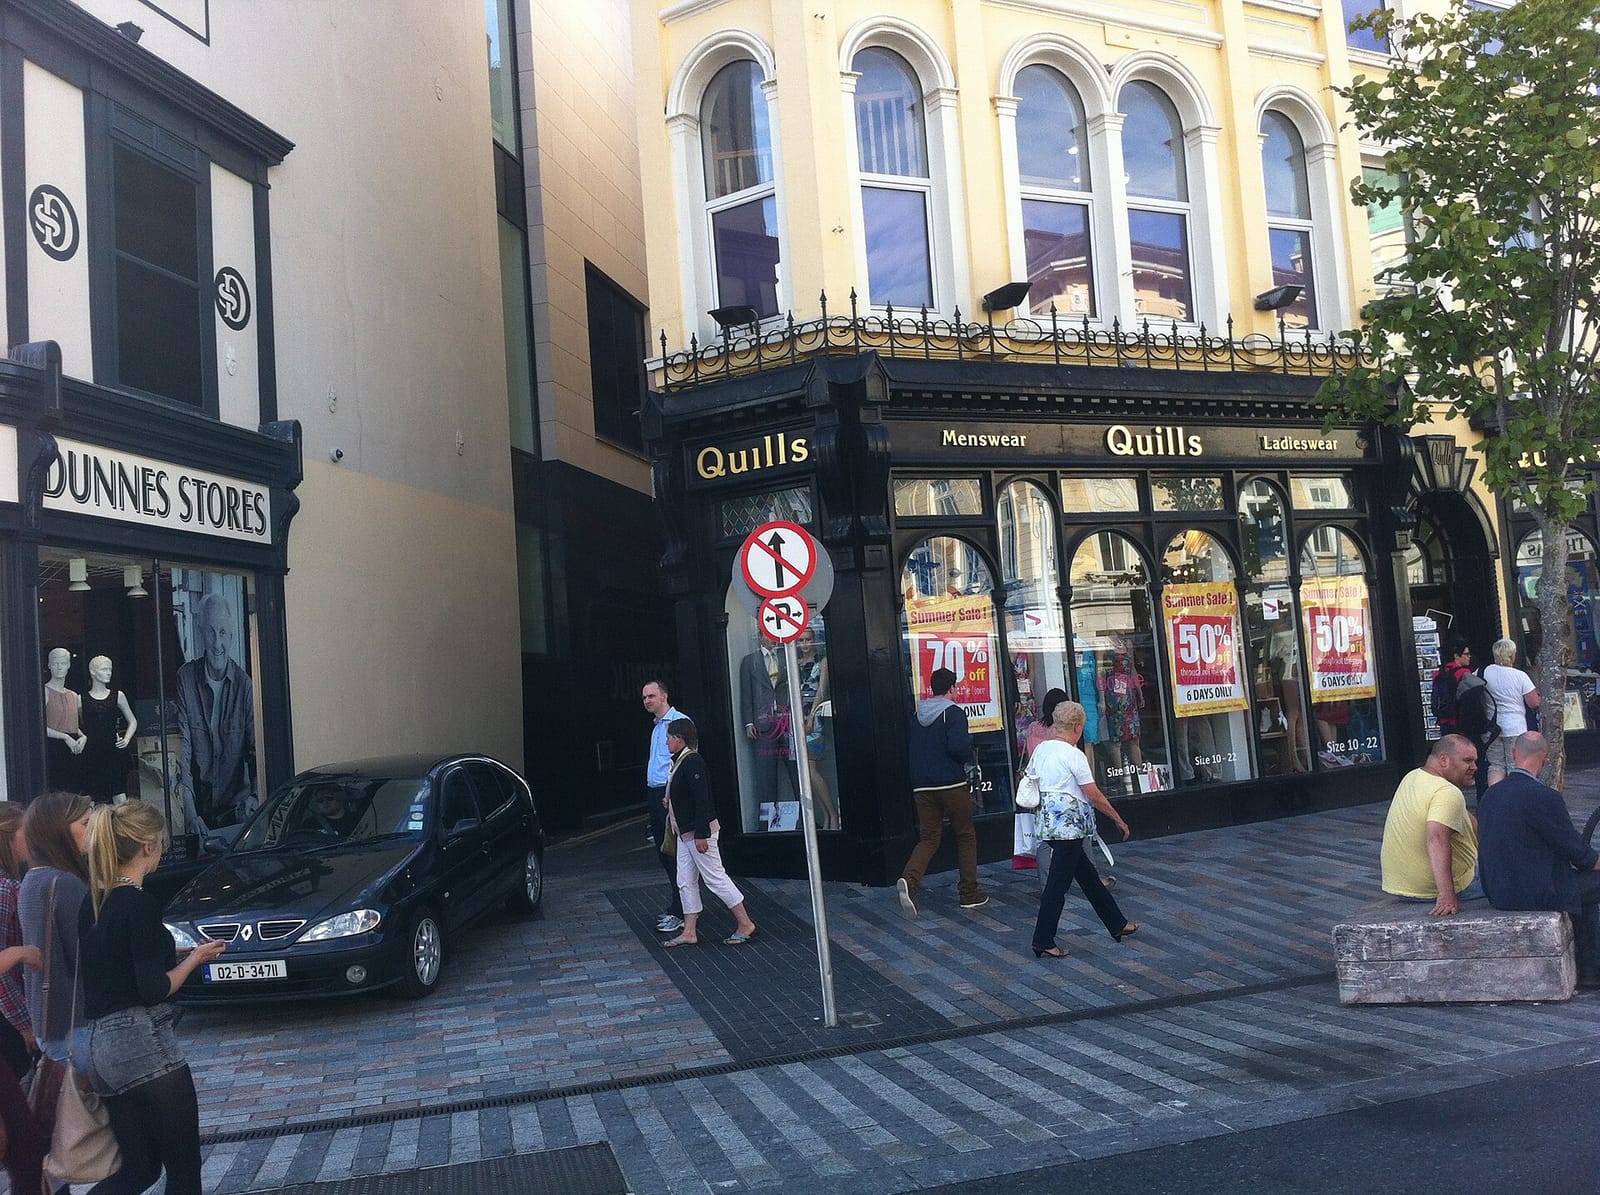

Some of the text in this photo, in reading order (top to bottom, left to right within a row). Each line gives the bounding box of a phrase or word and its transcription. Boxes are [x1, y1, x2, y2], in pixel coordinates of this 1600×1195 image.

[942, 429, 1027, 448] Menswear
[1106, 424, 1203, 456] Quills
[1263, 435, 1338, 451] Ladieswear
[696, 432, 809, 480] Quills
[43, 448, 267, 536] DUNNES STORES
[1165, 594, 1205, 608] Summer
[1303, 588, 1337, 600] Summer
[911, 610, 956, 624] Summer
[1315, 615, 1363, 653] 50%
[1179, 623, 1231, 664] 50%
[969, 668, 986, 682] off
[1322, 677, 1328, 688] 6
[1328, 675, 1345, 687] DAYS
[1186, 686, 1233, 702] 6 DAYS ONLY
[964, 704, 986, 718] ONLY
[1326, 741, 1346, 753] Size
[1347, 739, 1359, 751] 10
[1366, 737, 1378, 748] 22
[1195, 755, 1211, 766] Size
[1212, 754, 1221, 764] 10
[1227, 752, 1237, 762] 22
[1107, 767, 1123, 777] Size
[1125, 764, 1135, 774] 10
[1142, 762, 1152, 772] 22
[981, 781, 992, 791] 22
[217, 963, 278, 979] 02-D-34711
